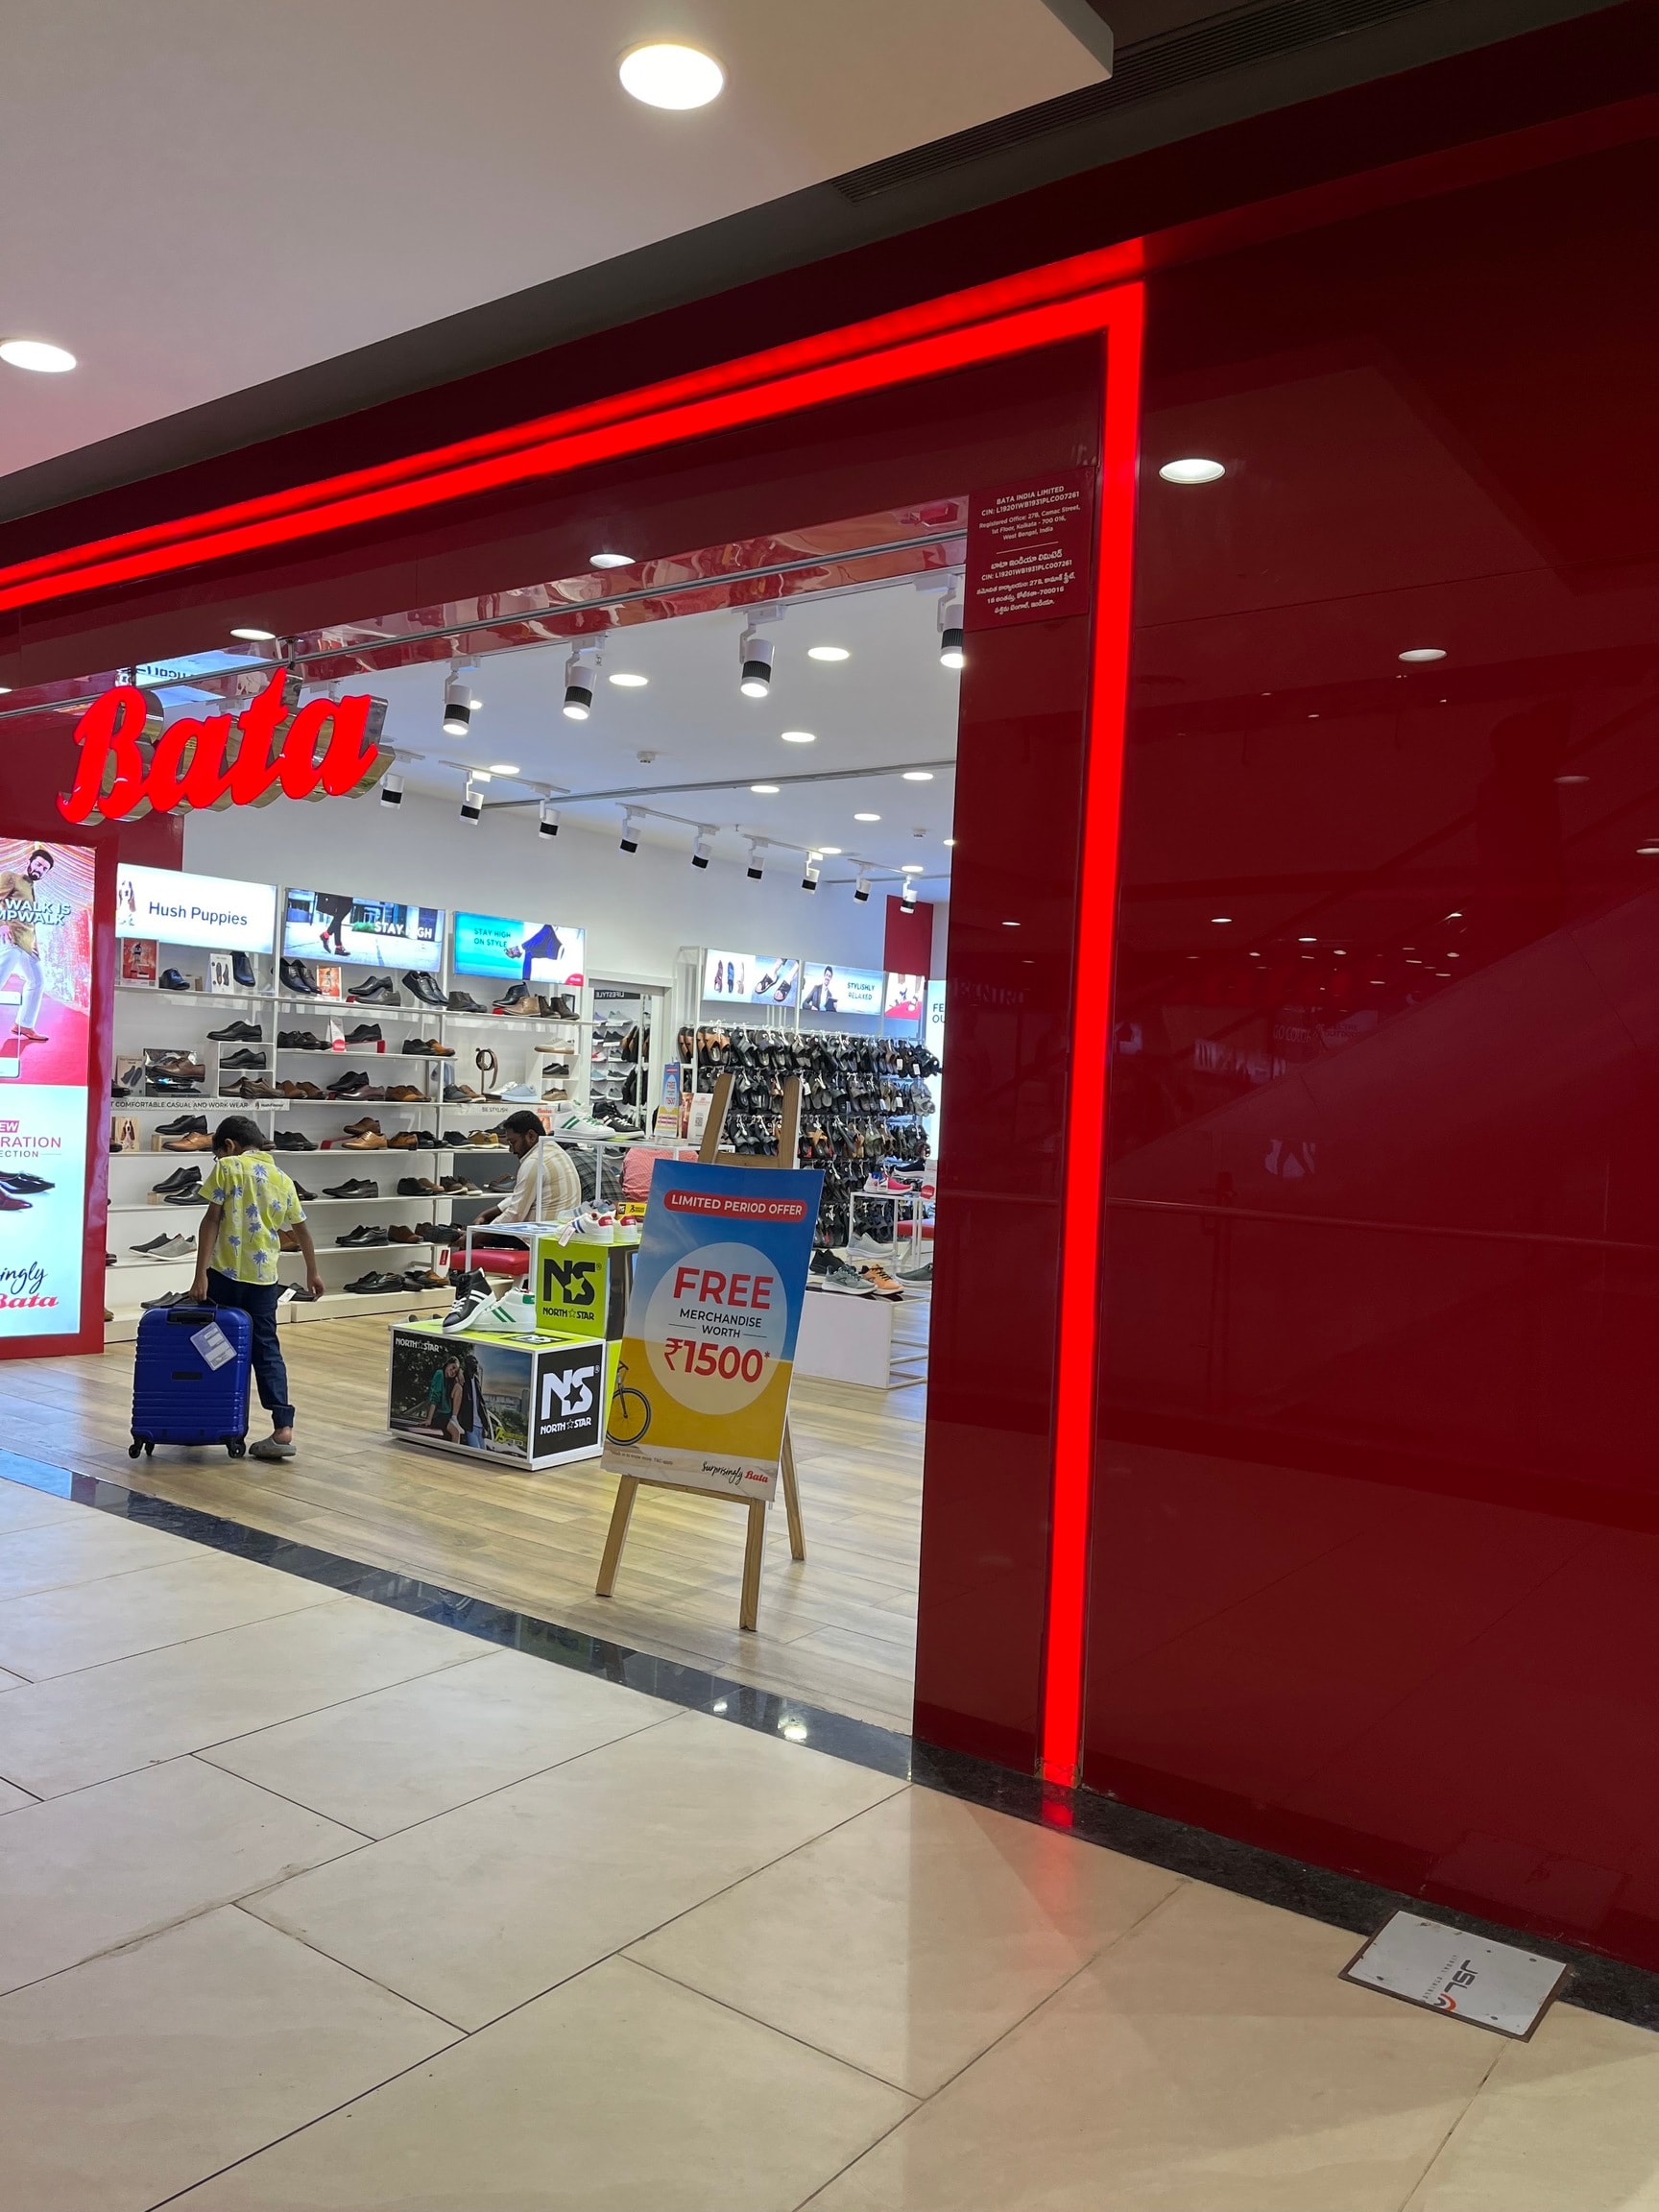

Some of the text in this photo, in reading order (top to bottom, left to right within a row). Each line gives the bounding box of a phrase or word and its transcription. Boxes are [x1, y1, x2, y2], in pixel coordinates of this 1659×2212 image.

[997, 486, 1064, 505] BATA INDIA LIMITED
[979, 518, 1007, 529] Registered
[1016, 521, 1037, 530] Kolkata
[56, 666, 380, 825] Bata
[5, 899, 71, 915] WALK IS
[149, 901, 248, 926] Hush Puppies
[373, 921, 404, 935] STAY
[473, 927, 493, 937] STAY
[486, 938, 508, 948] STYLE
[847, 981, 876, 992] STYLISHLY
[848, 992, 873, 1000] RELAXED
[671, 1194, 803, 1215] LIMITED PERIOD OFFER
[673, 1266, 774, 1310] FREE
[542, 1307, 594, 1320] NORTH STAR
[679, 1308, 762, 1328] MERCHANDISE
[701, 1324, 741, 1338] WORTH
[395, 1337, 440, 1353] NORTH STAR
[541, 1417, 592, 1435] NORTH STAR
[701, 1460, 769, 1486] Surprisingly Bata
